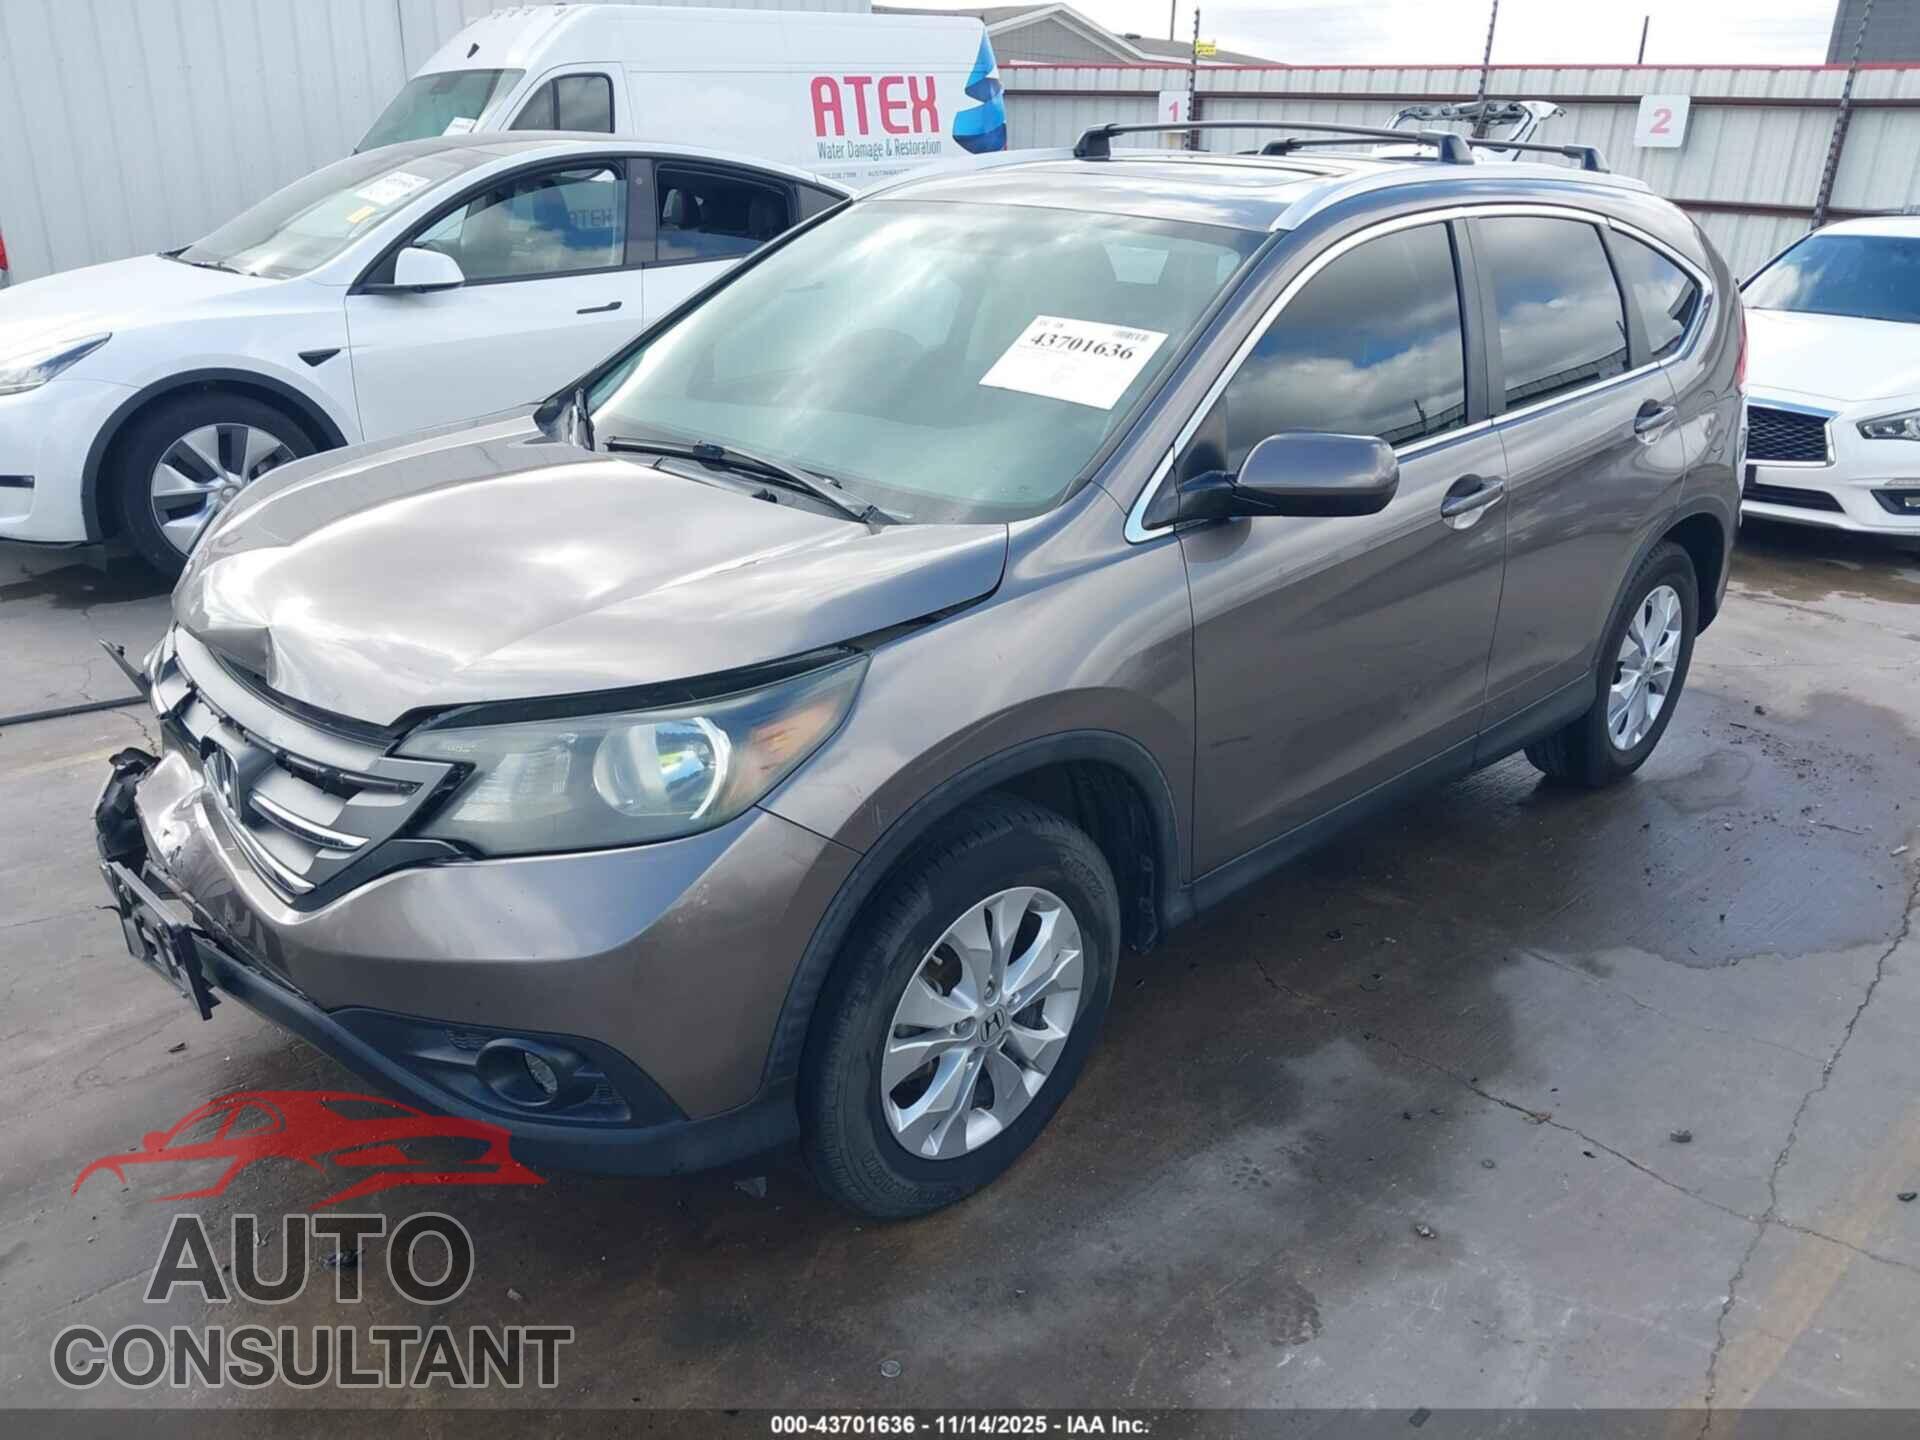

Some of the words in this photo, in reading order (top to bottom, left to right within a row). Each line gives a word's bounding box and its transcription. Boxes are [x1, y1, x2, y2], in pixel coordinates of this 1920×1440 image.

[811, 76, 939, 137] ATEX
[1168, 101, 1179, 122] 1
[1648, 108, 1672, 134] 2
[817, 141, 844, 160] Water
[848, 140, 884, 161] Damage
[886, 138, 893, 157] &
[895, 137, 942, 156] Restoration
[1031, 331, 1136, 360] 43701636
